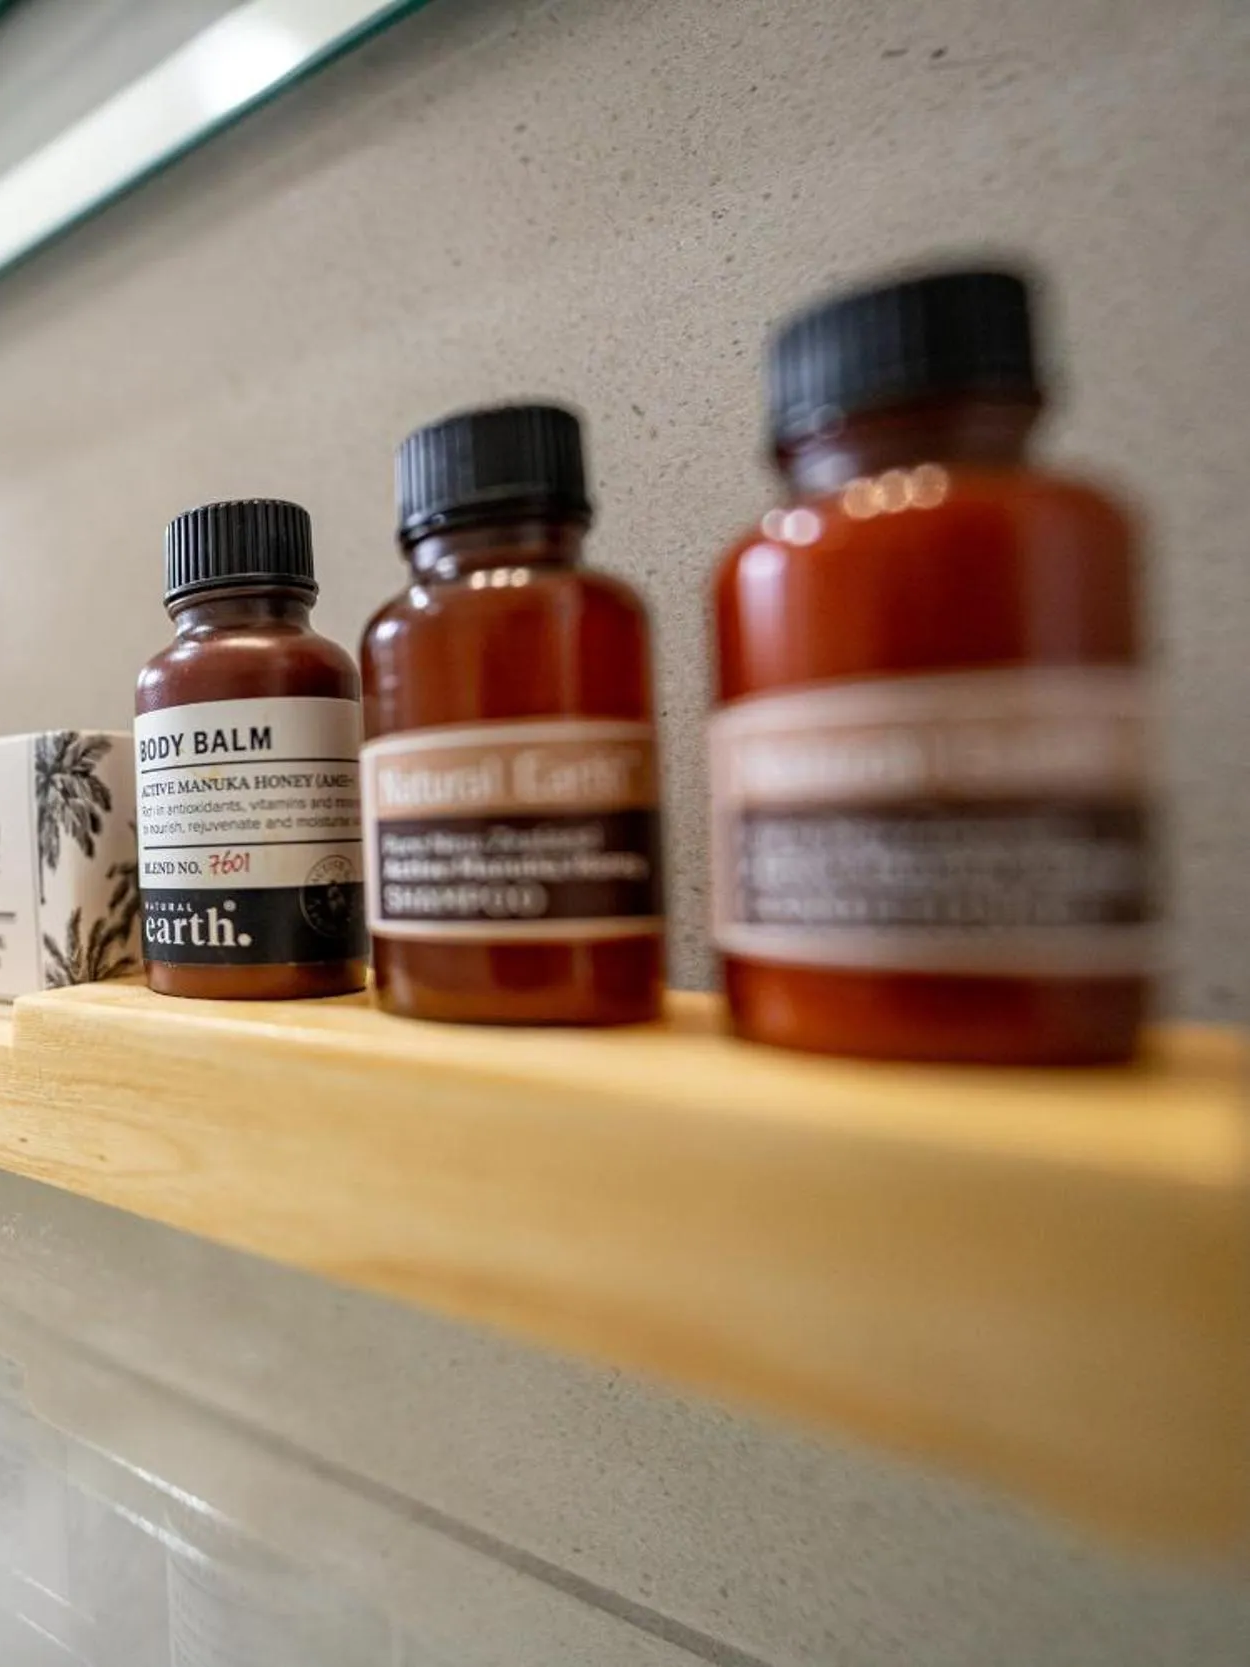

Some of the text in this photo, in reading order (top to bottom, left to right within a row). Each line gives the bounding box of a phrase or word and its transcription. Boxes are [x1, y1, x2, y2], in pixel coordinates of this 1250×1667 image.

[139, 726, 273, 763] BODY BALM
[141, 780, 176, 798] ACTIVE
[177, 775, 250, 794] MANUKA
[253, 773, 313, 790] HONEY
[248, 797, 308, 811] vitamins
[310, 796, 333, 811] and
[187, 817, 261, 836] rejuvenate
[264, 815, 293, 830] and
[144, 861, 202, 875] BLEND NO.
[145, 900, 194, 912] NATURAL
